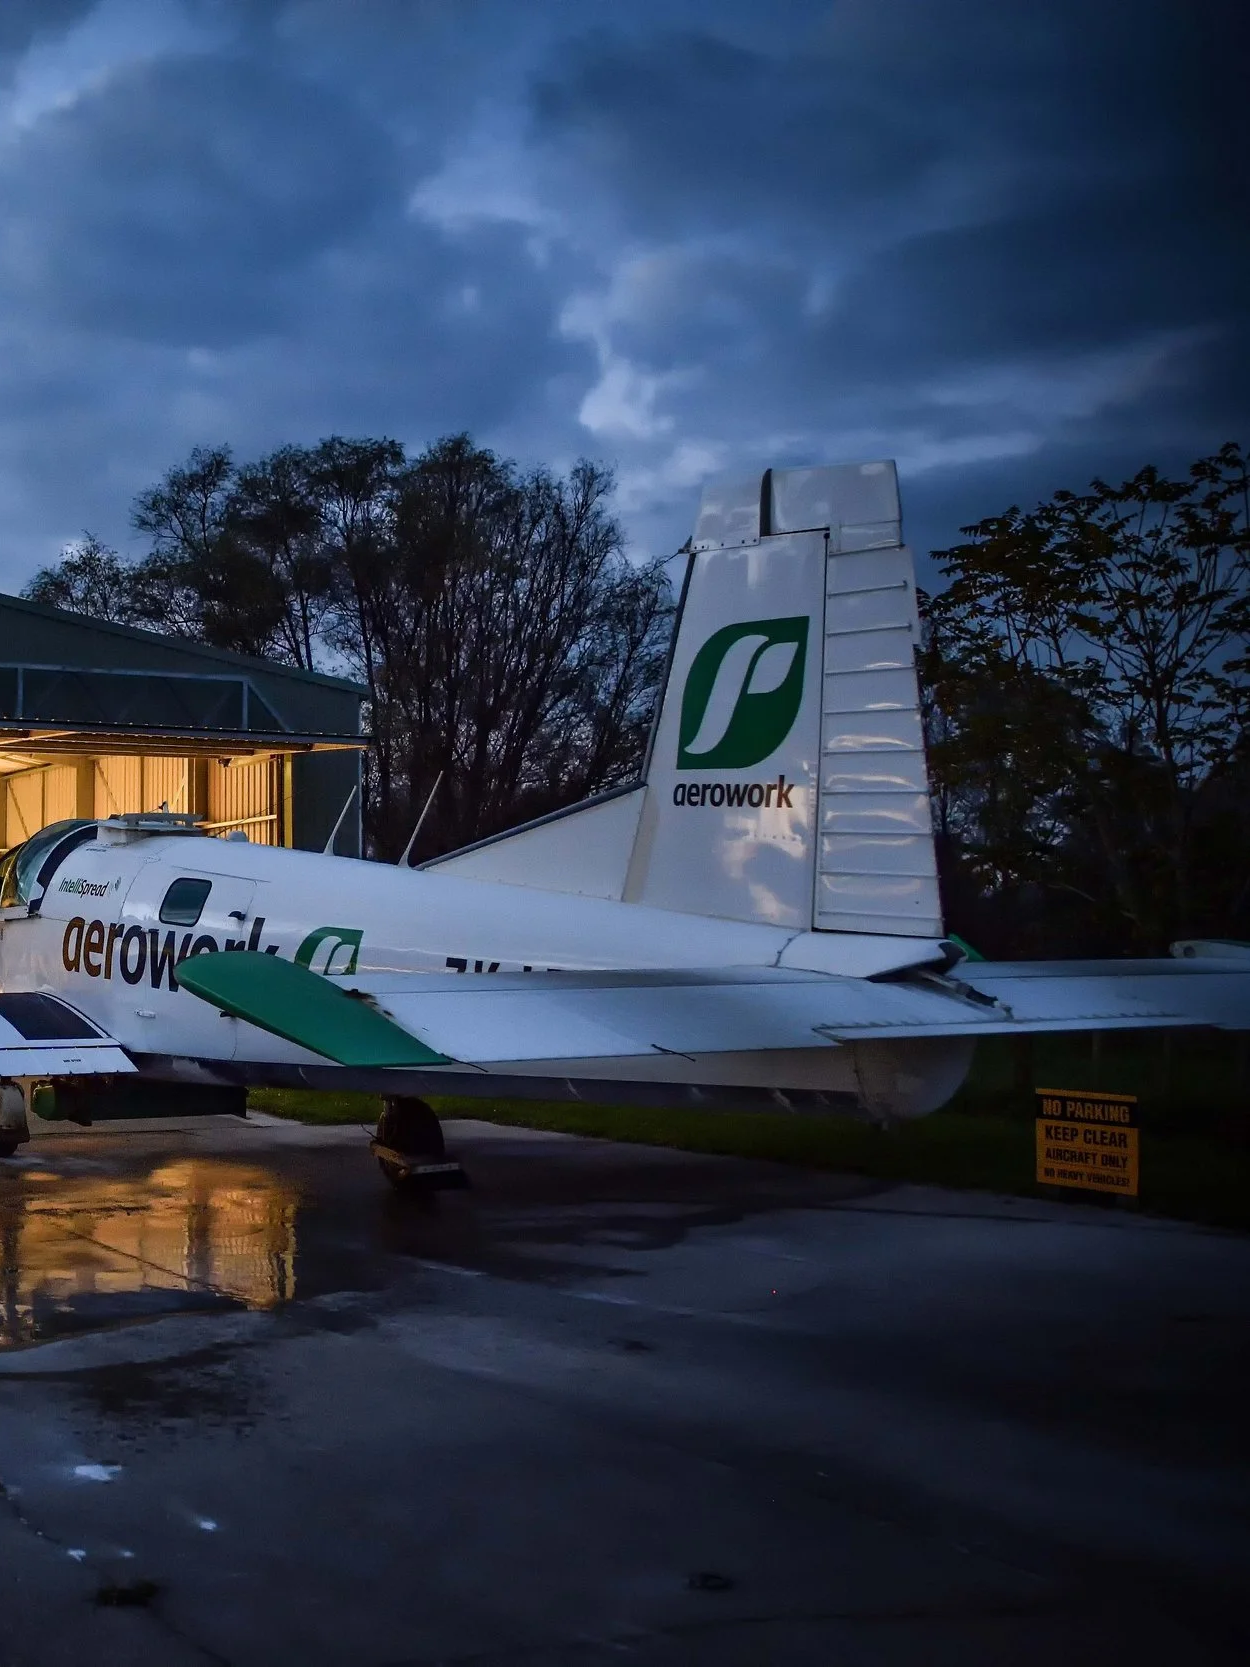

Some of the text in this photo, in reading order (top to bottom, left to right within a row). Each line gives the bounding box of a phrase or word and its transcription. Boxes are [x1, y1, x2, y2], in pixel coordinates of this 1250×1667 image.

[673, 774, 795, 808] aerowork
[58, 877, 110, 899] IntelliSpread
[1042, 1098, 1131, 1124] NO PARKING
[1045, 1125, 1128, 1149] KEEP CLEAR
[1045, 1147, 1128, 1169] AIRCRAFT ONLY
[1044, 1167, 1055, 1177] NO
[1056, 1168, 1083, 1181] HEAVY
